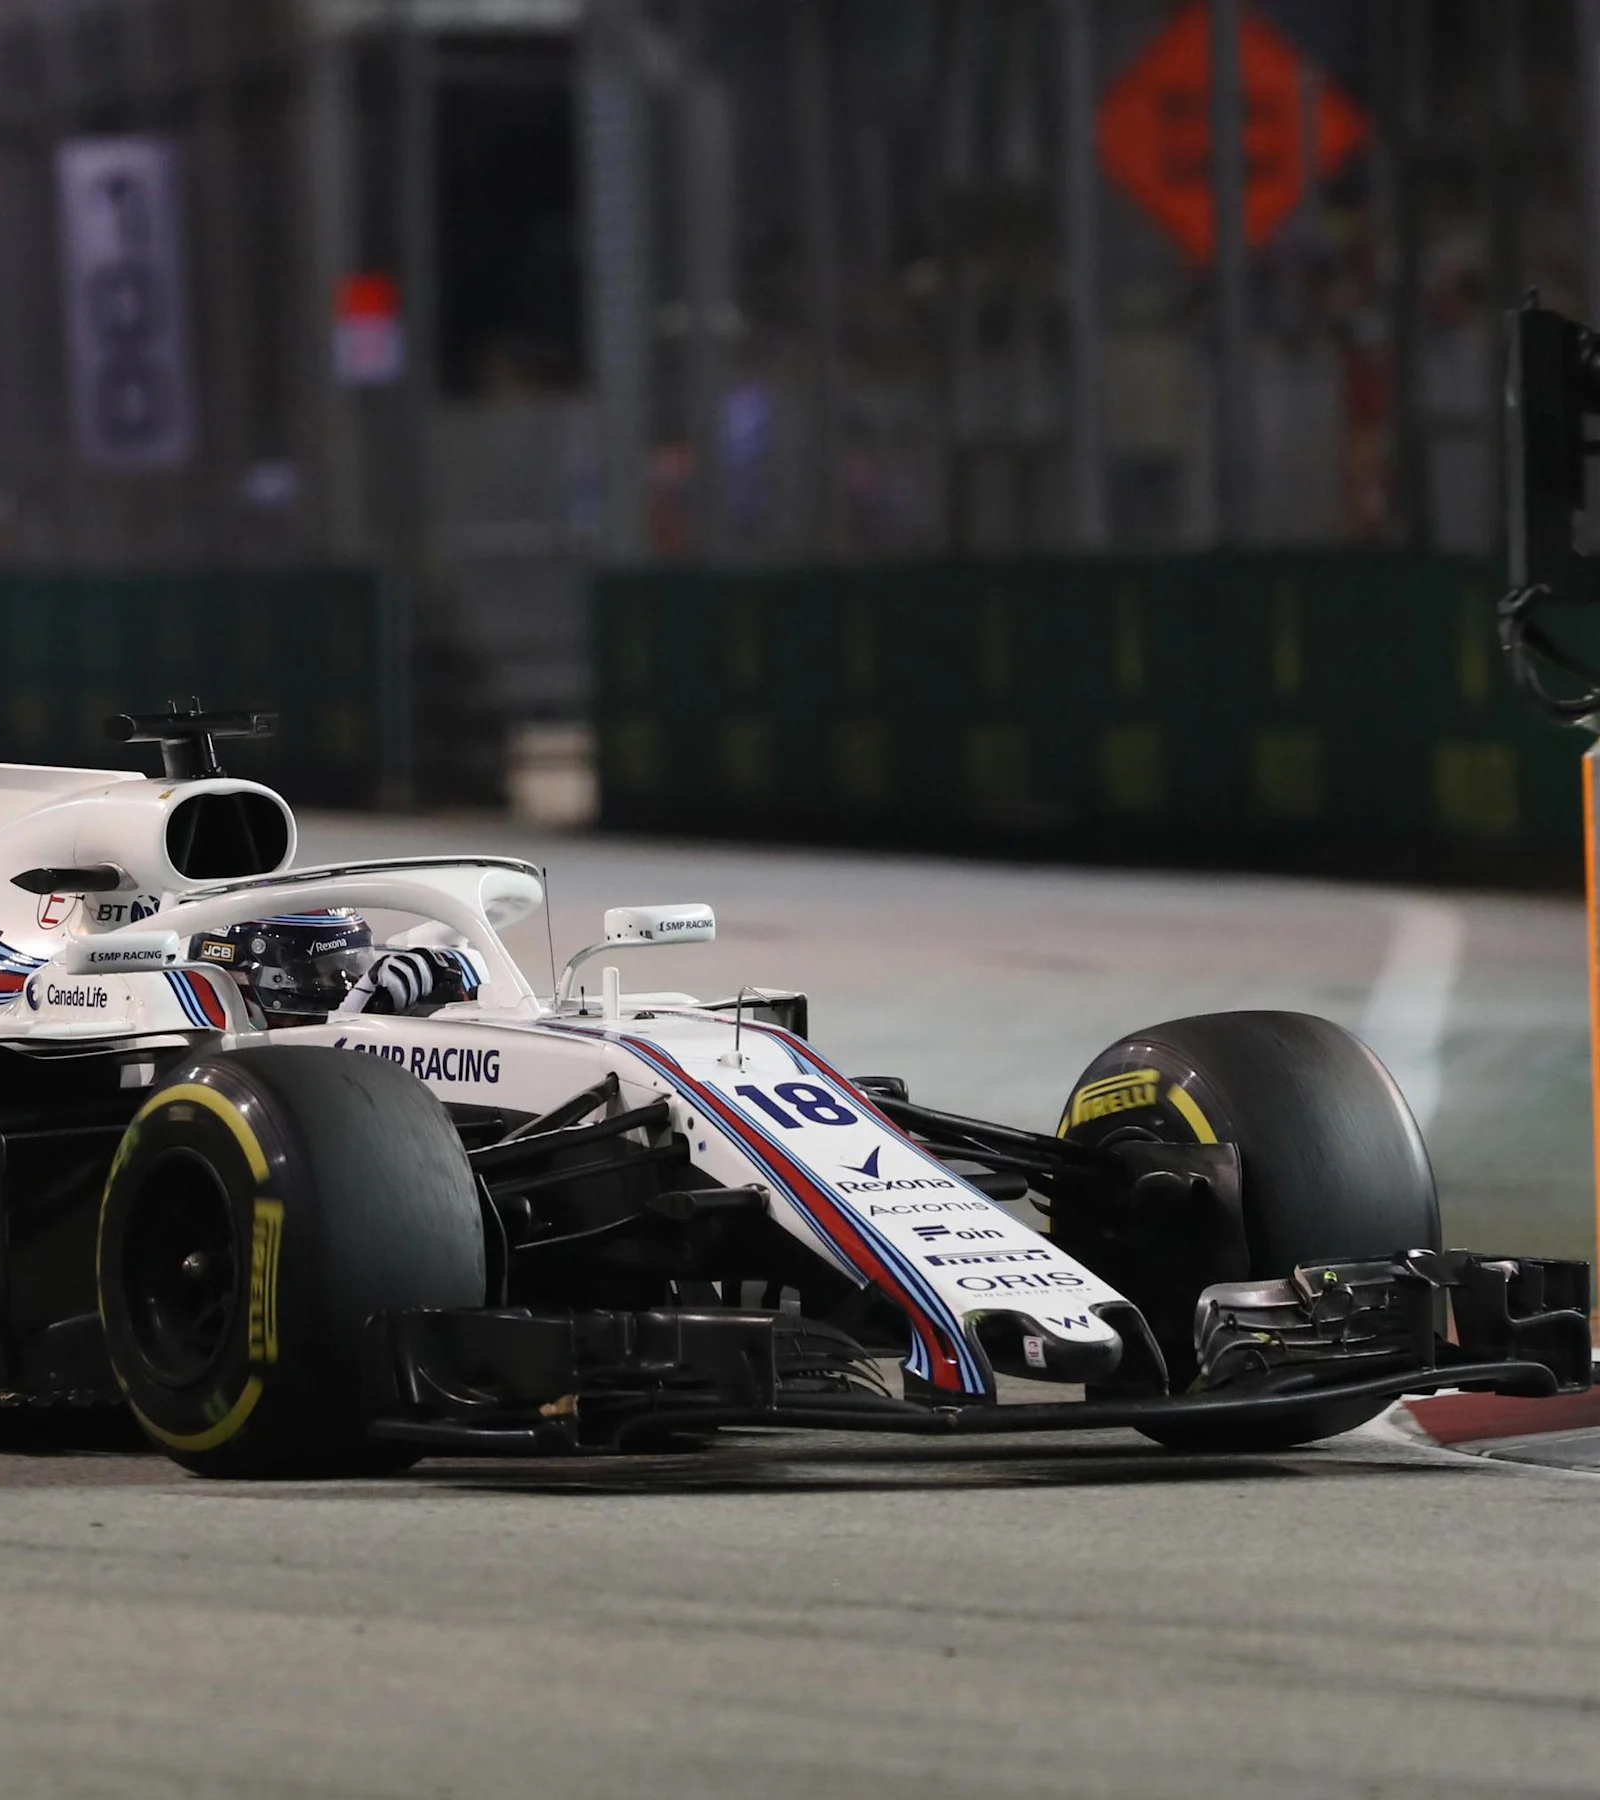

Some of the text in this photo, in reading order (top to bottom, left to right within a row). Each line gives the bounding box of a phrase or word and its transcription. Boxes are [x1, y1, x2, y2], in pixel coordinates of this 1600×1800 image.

[97, 904, 128, 922] BT
[666, 919, 714, 931] SMP RACING
[203, 944, 233, 959] JCB
[315, 936, 348, 953] Rexona
[97, 950, 162, 962] SMP RACING
[47, 983, 108, 1009] Canada Life
[410, 1046, 501, 1084] RACING
[734, 1082, 858, 1130] 18
[835, 1178, 956, 1194] Rexona
[870, 1201, 990, 1217] Acronis
[923, 1249, 1053, 1267] PIRELLI
[956, 1271, 1084, 1291] ORIS
